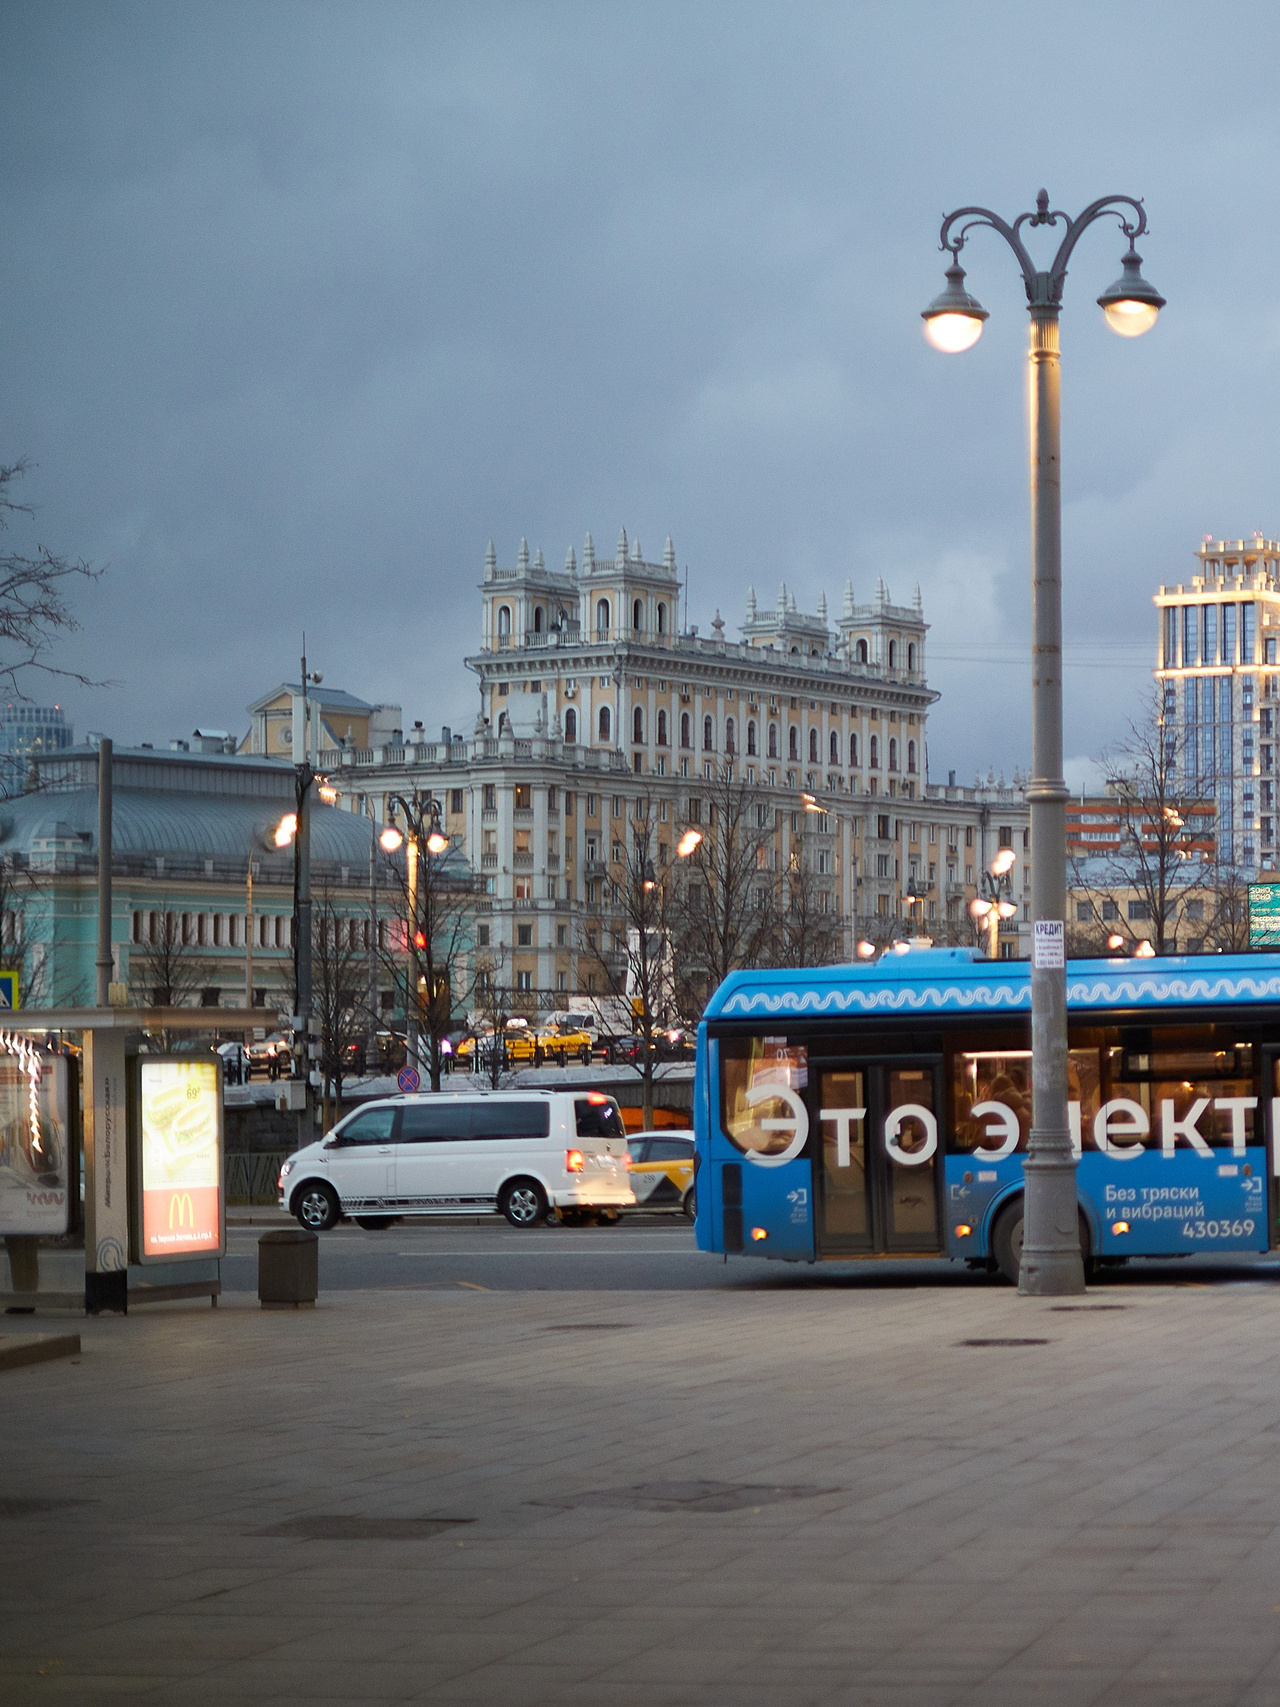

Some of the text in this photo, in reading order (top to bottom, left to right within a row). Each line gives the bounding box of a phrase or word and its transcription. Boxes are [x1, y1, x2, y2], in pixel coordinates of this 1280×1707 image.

[1036, 923, 1062, 936] КРЕДИТ
[744, 1084, 938, 1167] Это
[1105, 1184, 1199, 1204] Без тряски
[1106, 1201, 1205, 1221] и вибраций
[1183, 1219, 1255, 1239] 430369
